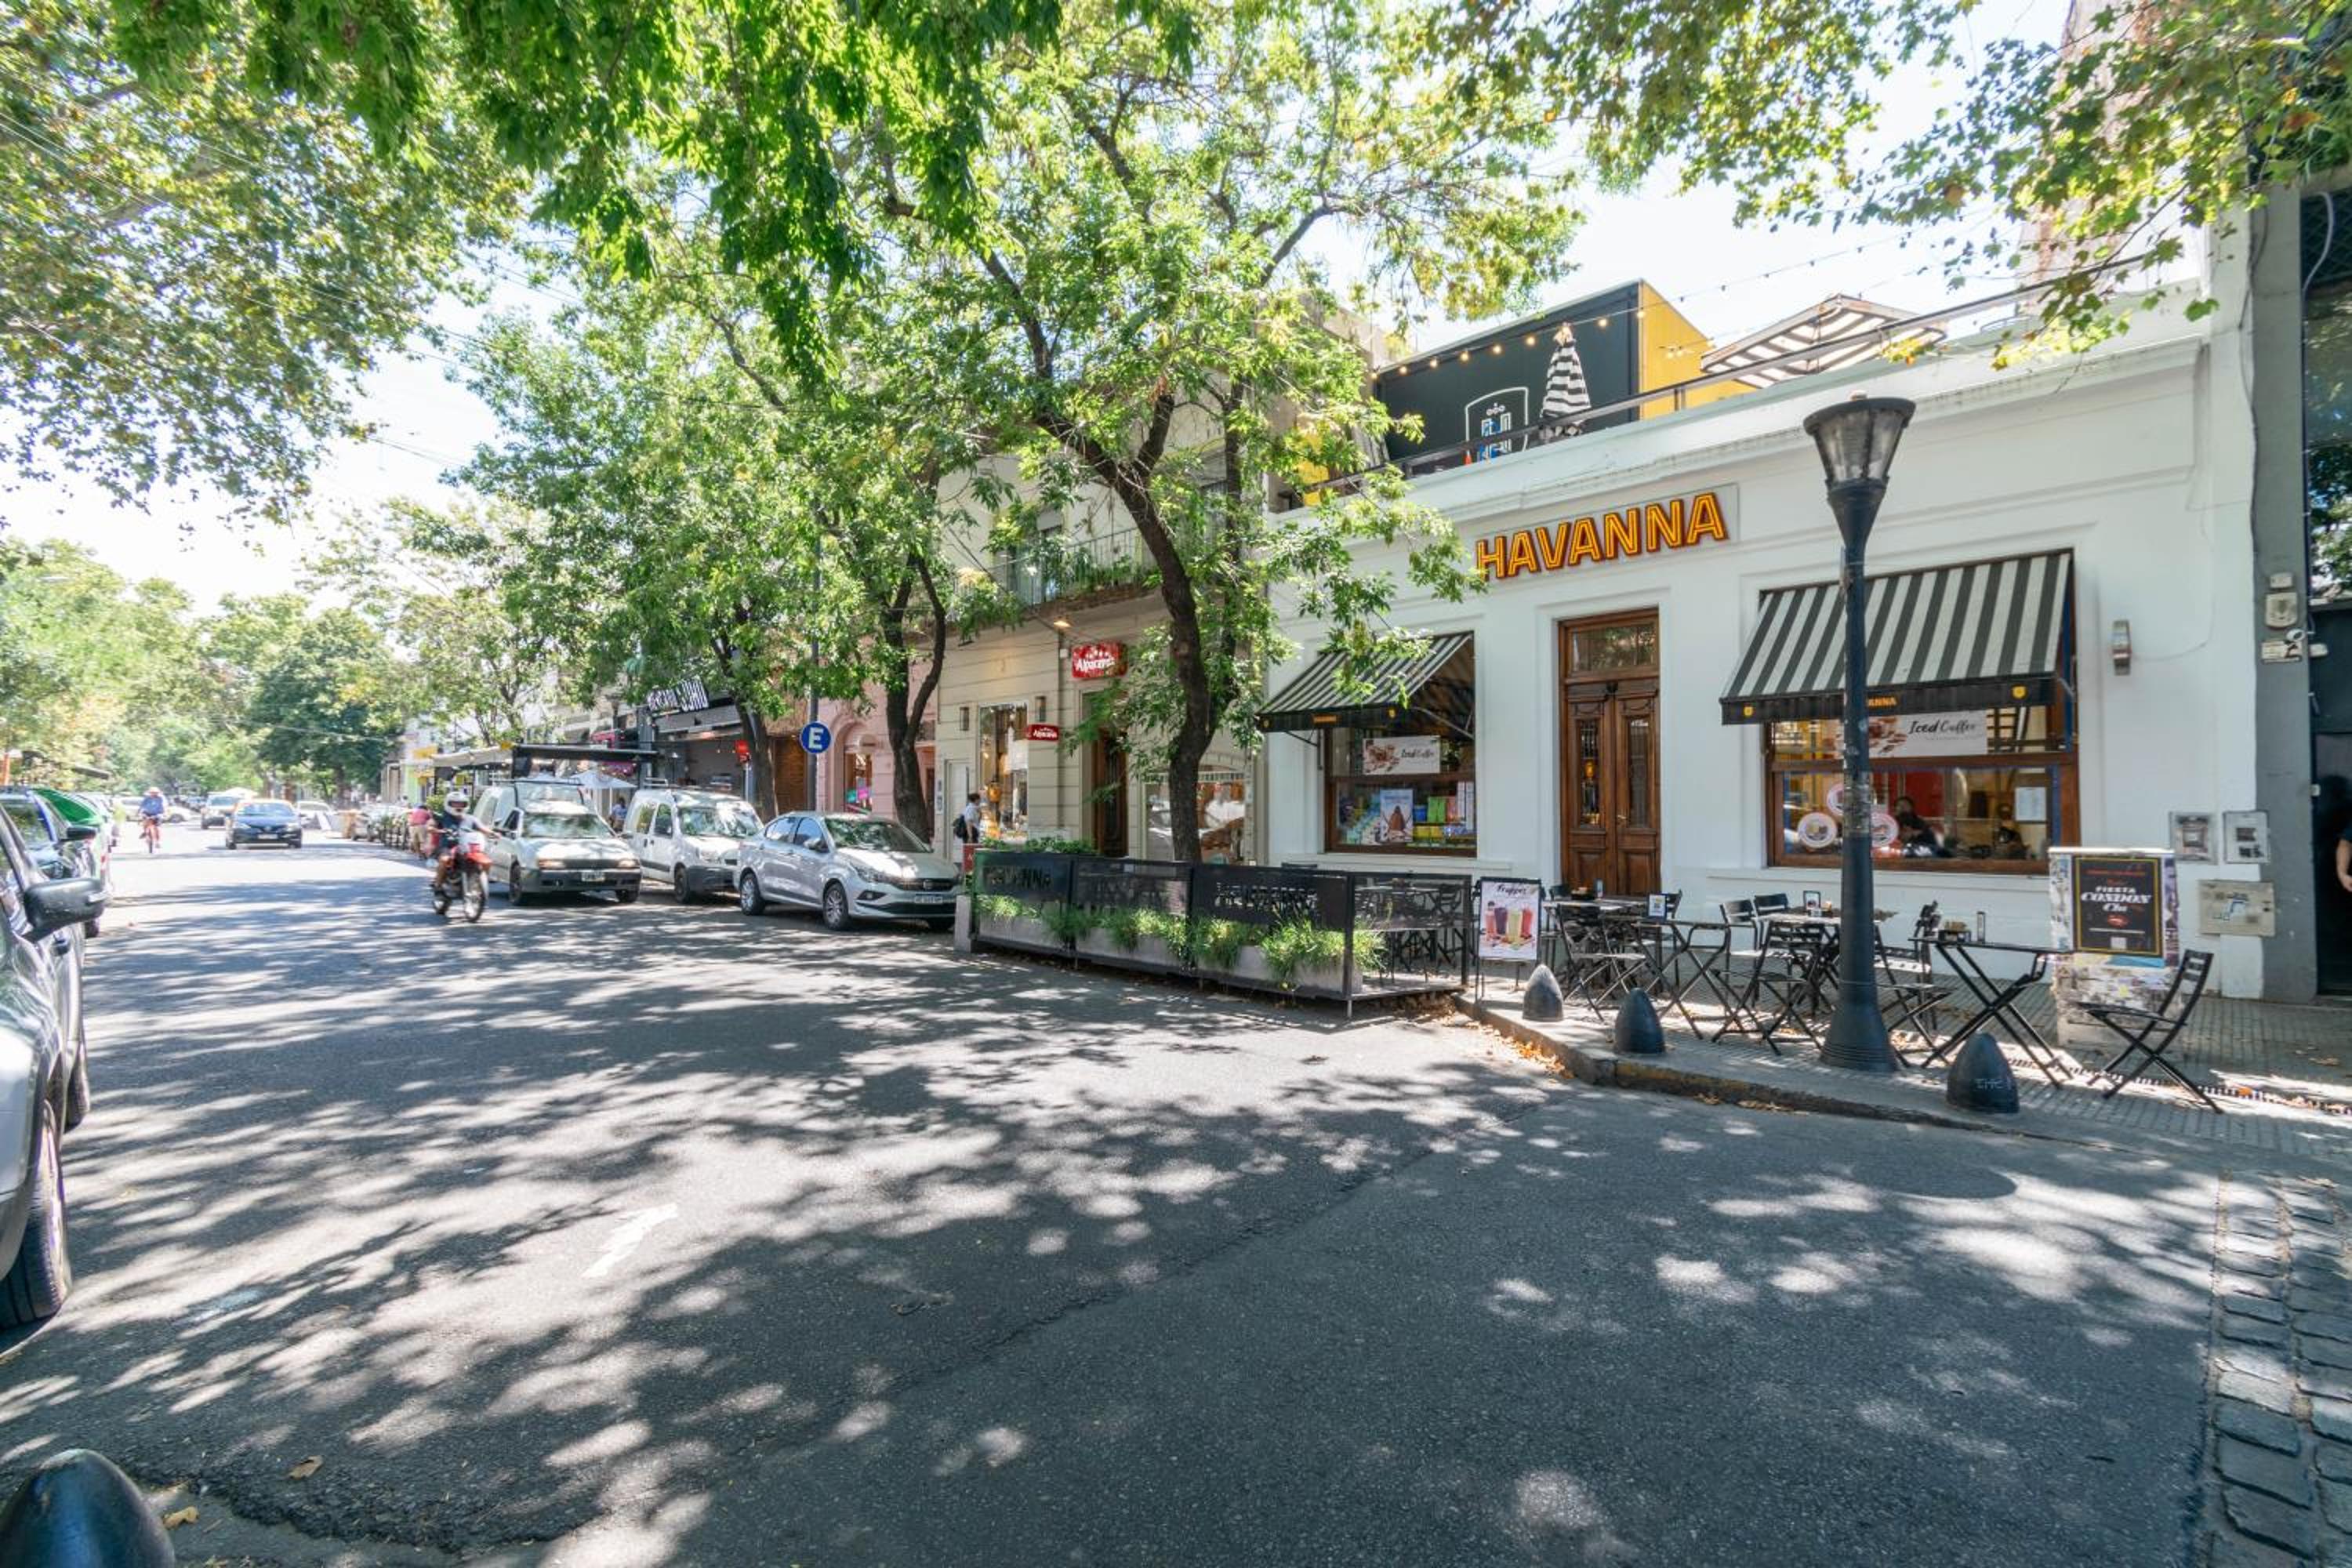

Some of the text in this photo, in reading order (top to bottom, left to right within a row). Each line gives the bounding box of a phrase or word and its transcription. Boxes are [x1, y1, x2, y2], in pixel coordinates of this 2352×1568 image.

[1476, 492, 1730, 580] HAVANNA
[1908, 720, 1940, 734] Iced
[808, 727, 824, 750] E
[2095, 885, 2136, 894] FIESTA
